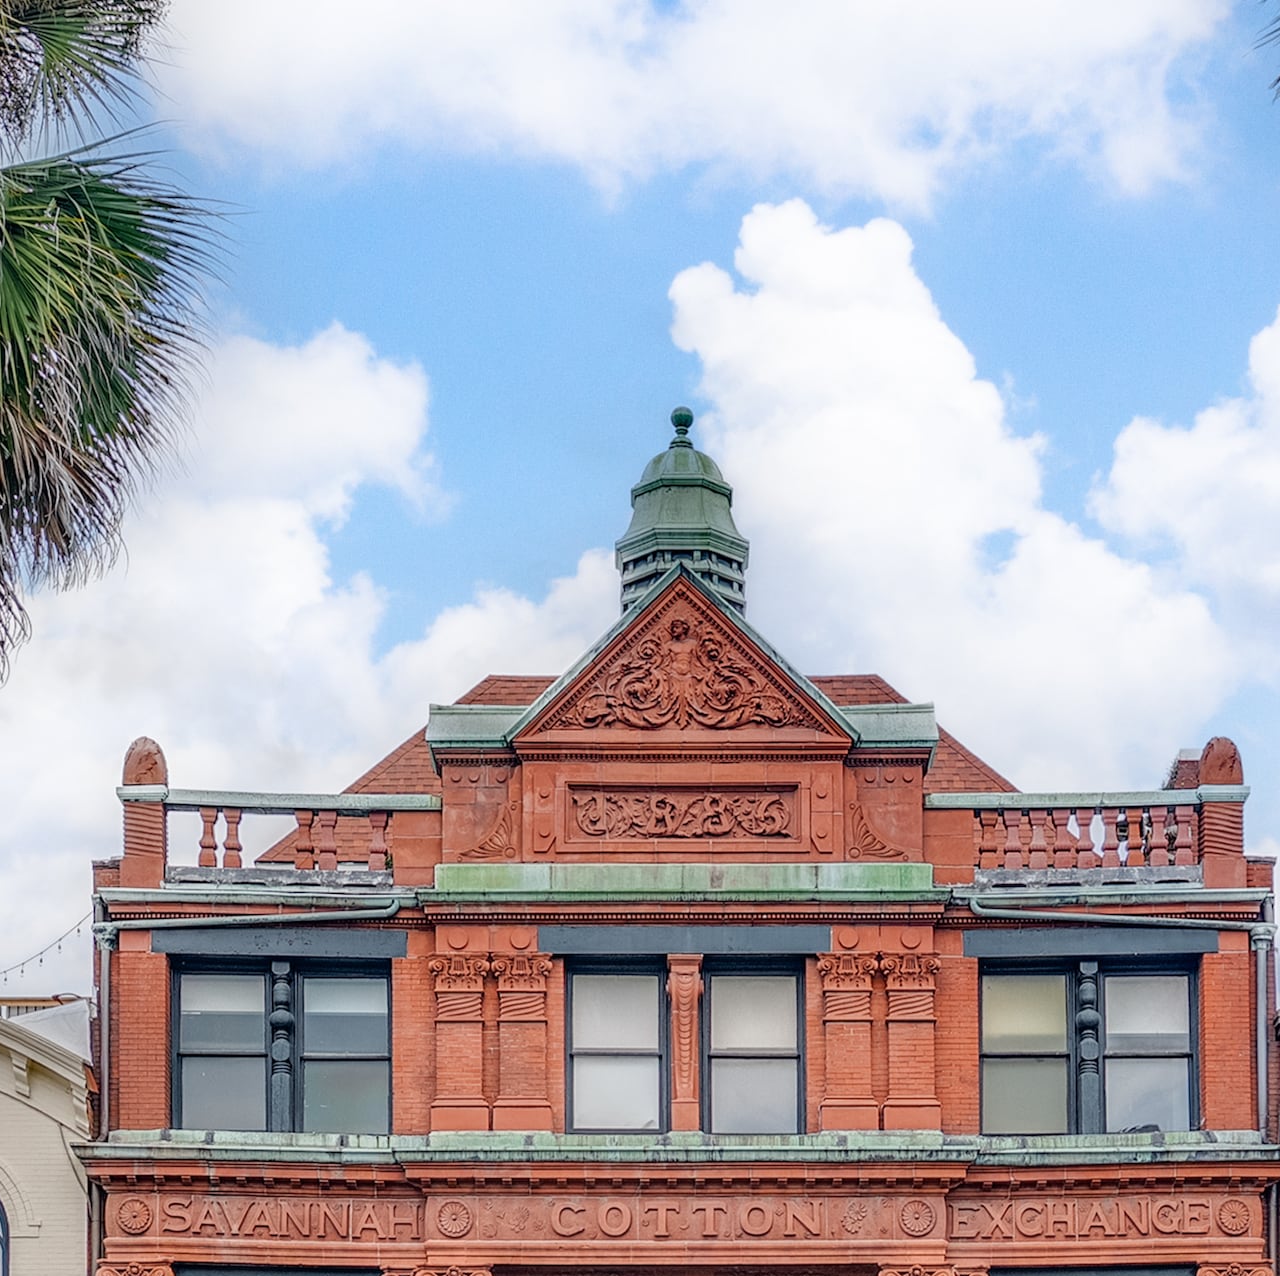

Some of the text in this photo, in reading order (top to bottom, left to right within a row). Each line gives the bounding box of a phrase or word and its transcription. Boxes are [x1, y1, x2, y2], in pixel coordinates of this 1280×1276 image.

[162, 1198, 1211, 1240] SAVANNAH COTTON EXCHANGE
